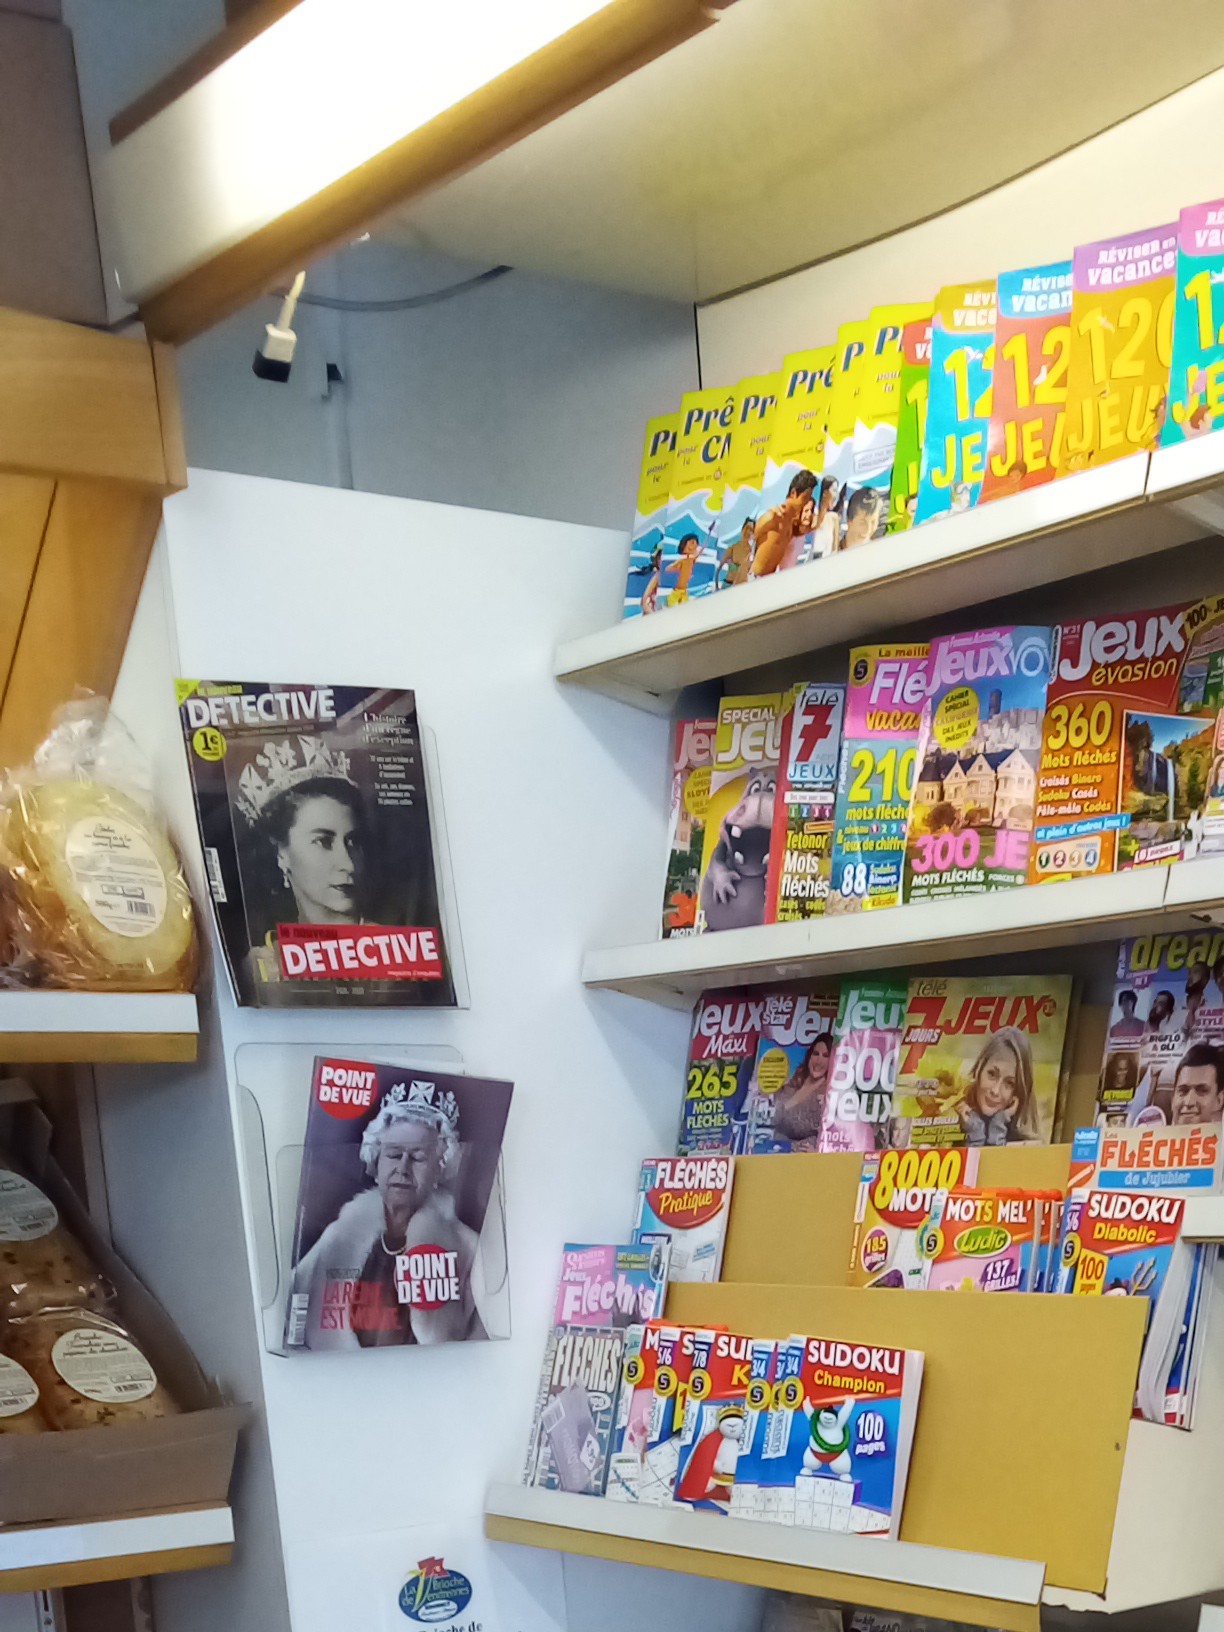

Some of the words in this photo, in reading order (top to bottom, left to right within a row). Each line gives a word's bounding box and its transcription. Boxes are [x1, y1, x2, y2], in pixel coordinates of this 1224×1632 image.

[1058, 612, 1187, 682] Jeux
[1092, 657, 1177, 687] évasion
[188, 689, 336, 728] DETECTIVE
[722, 707, 776, 724] SPECIAL
[1048, 700, 1113, 750] 360
[788, 762, 835, 779] JEUX
[1041, 753, 1071, 770] Mots
[784, 851, 819, 874] Mots
[912, 829, 980, 871] 300
[781, 874, 829, 899] fléchés
[841, 863, 866, 898] 88
[281, 931, 439, 976] DETECTIVE
[942, 994, 1051, 1036] JEUX
[904, 1028, 941, 1044] JOURS
[320, 1066, 376, 1089] POINT
[688, 1065, 739, 1099] 265
[319, 1086, 340, 1102] DE
[341, 1088, 372, 1107] VUE
[693, 1101, 725, 1116] MOTS
[1099, 1122, 1218, 1169] FLÉCHÉS
[655, 1158, 727, 1192] FLÉCHÉS
[873, 1149, 961, 1211] 8000
[1124, 1172, 1140, 1185] de
[659, 1188, 714, 1215] Pratique
[944, 1196, 994, 1223] MOTS
[1087, 1194, 1180, 1224] SUDOKU
[957, 1227, 1009, 1256] Ludic
[1093, 1222, 1157, 1245] Diabolic
[396, 1252, 458, 1281] POINT
[983, 1259, 1011, 1282] 137
[1079, 1254, 1105, 1282] 100
[398, 1280, 422, 1304] DE
[423, 1278, 459, 1302] VUE
[807, 1339, 901, 1376] SUDOKU
[813, 1369, 886, 1395] Champion
[856, 1412, 884, 1442] 100
[468, 1621, 483, 1632] de
